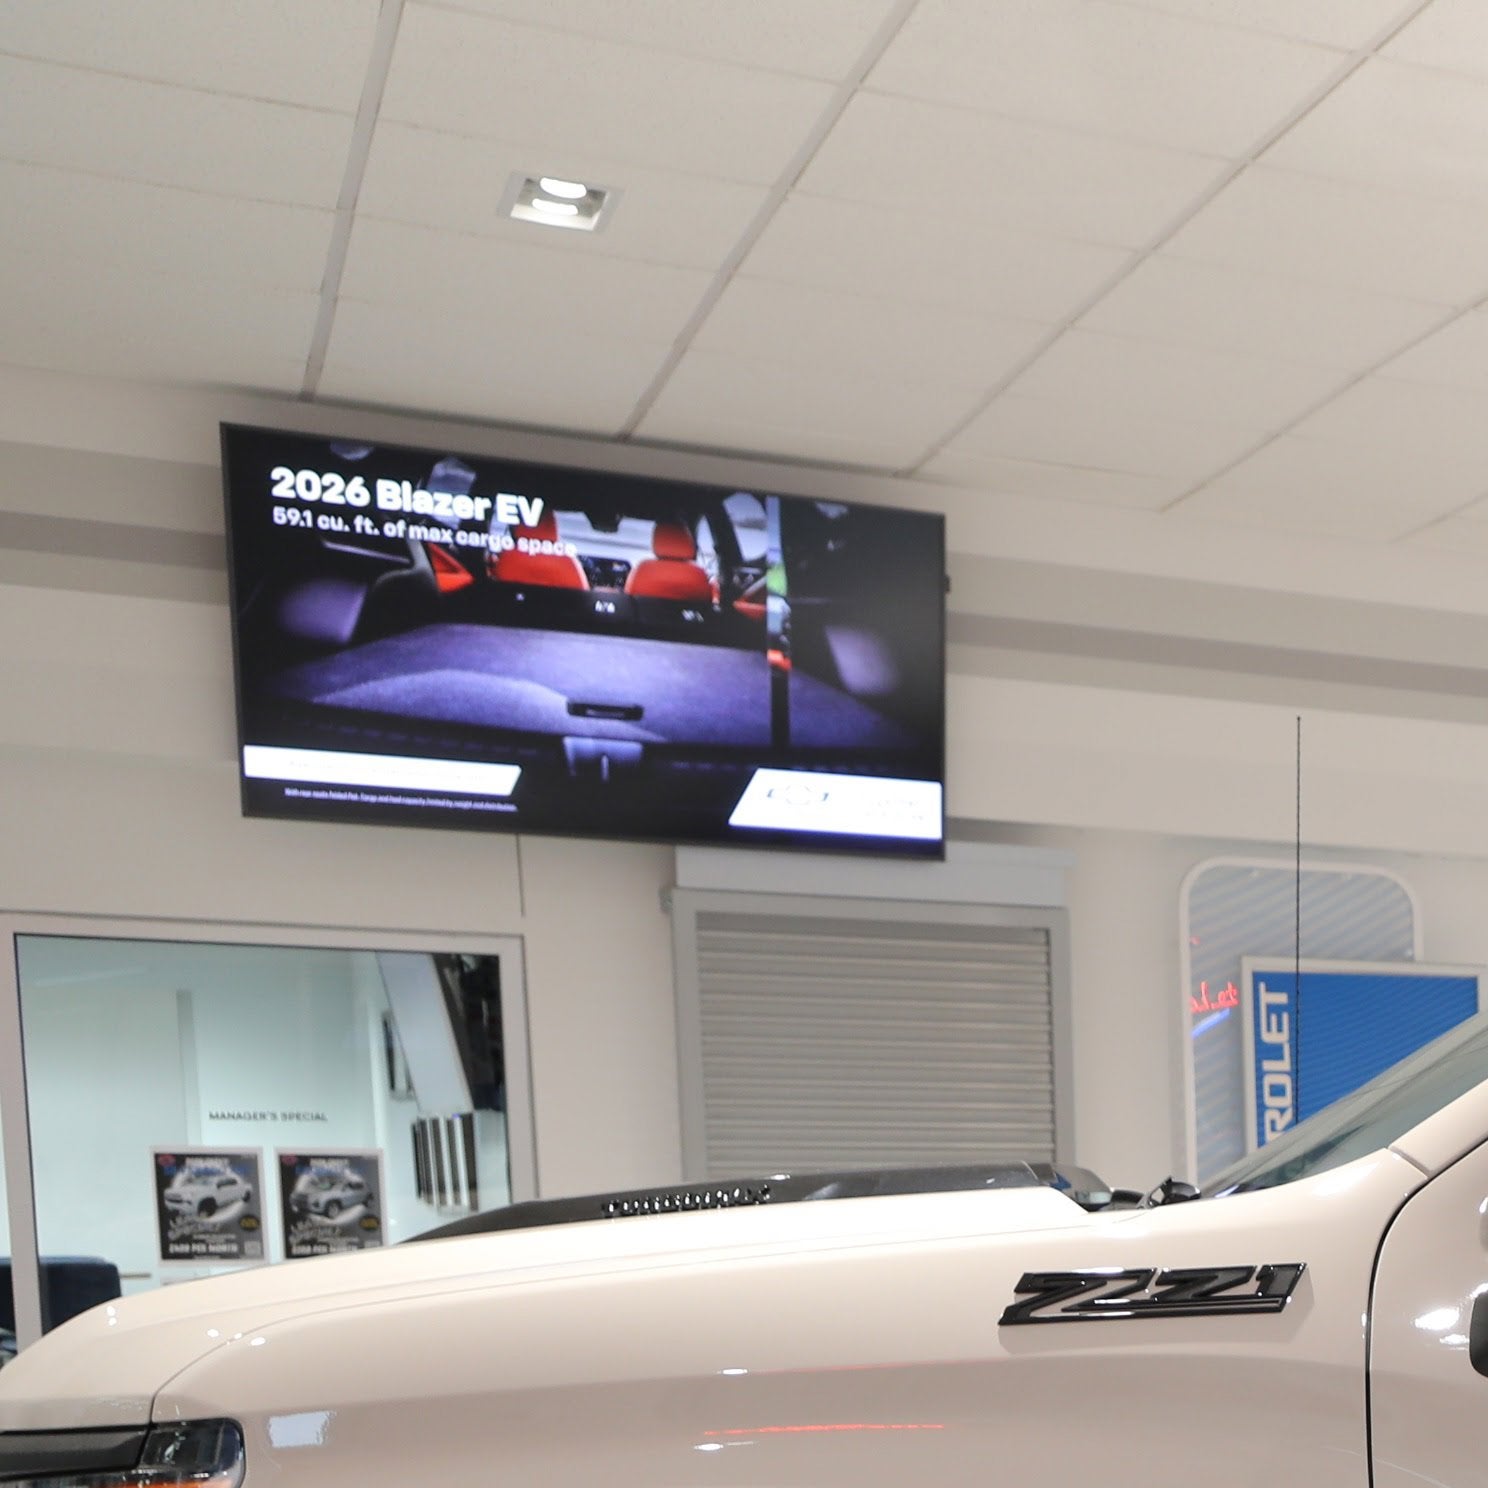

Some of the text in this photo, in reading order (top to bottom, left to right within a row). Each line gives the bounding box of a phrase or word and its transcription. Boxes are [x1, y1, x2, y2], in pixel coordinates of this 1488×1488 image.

[270, 466, 545, 527] 2026 Blazer EV
[272, 506, 579, 557] 59.1 cu. ft. of max cargo space
[209, 1110, 328, 1122] MANAGER'S SPECIAL
[998, 1262, 1307, 1326] Z71
